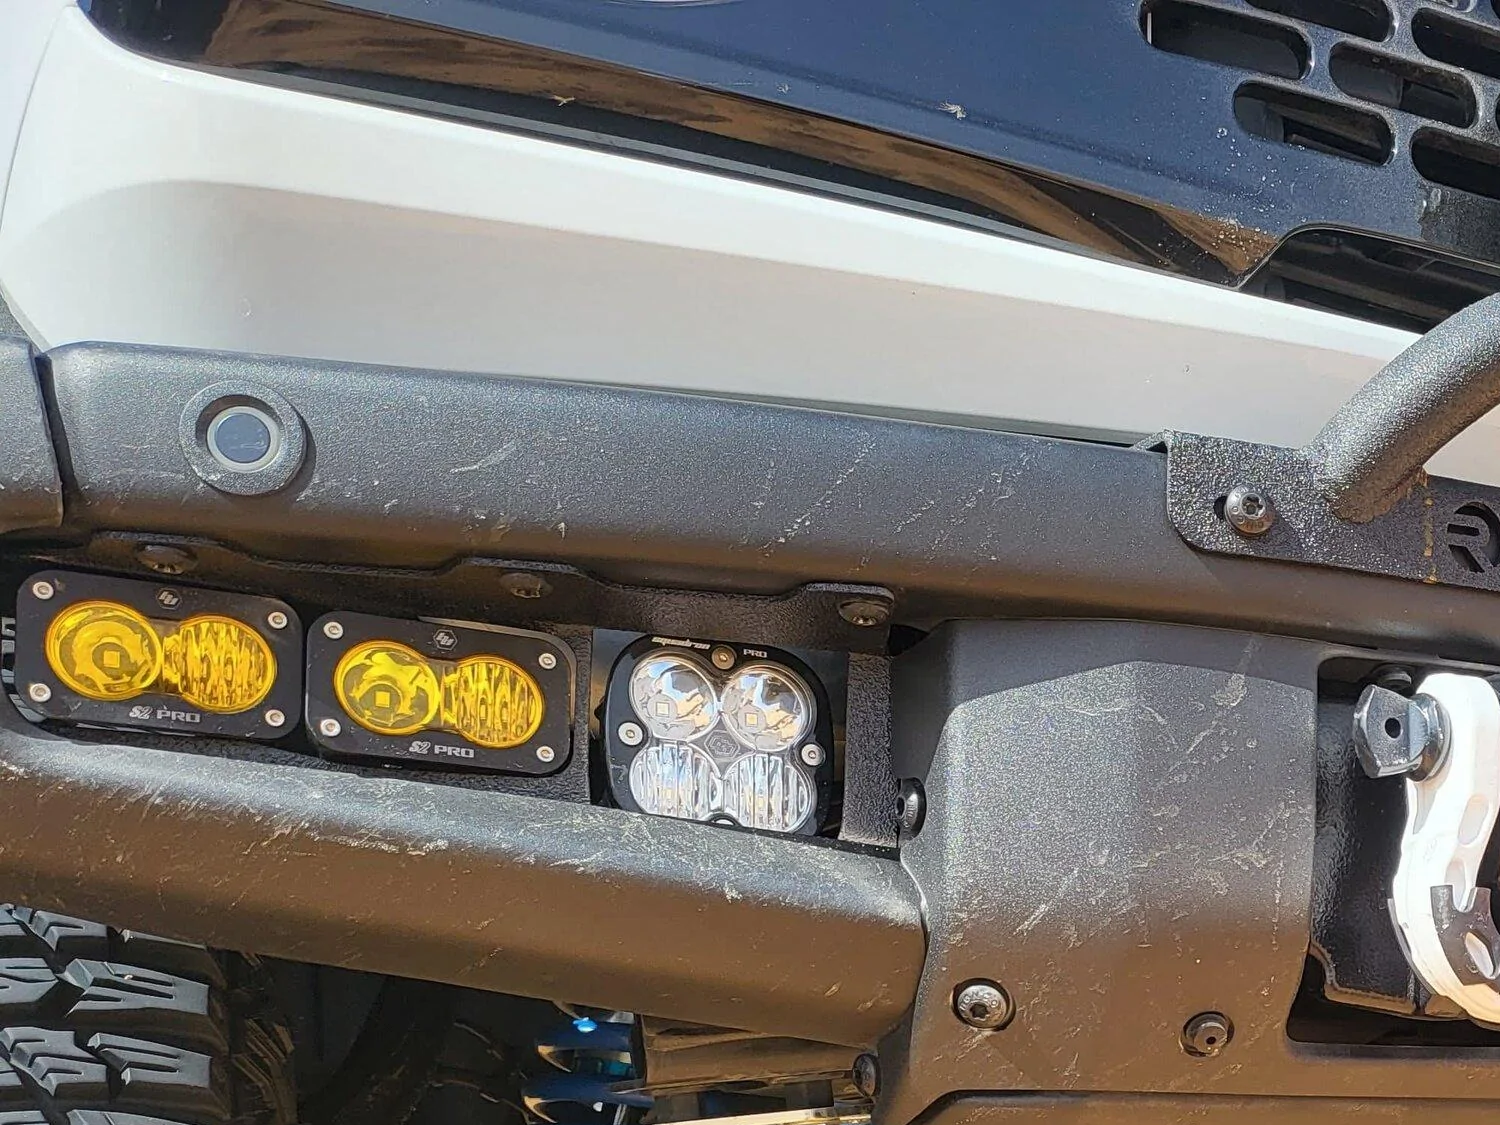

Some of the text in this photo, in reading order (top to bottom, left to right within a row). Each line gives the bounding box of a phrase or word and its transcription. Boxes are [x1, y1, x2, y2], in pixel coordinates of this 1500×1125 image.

[743, 648, 768, 658] PRO
[129, 705, 201, 723] S2 PRO
[409, 740, 475, 758] S2 PRO
